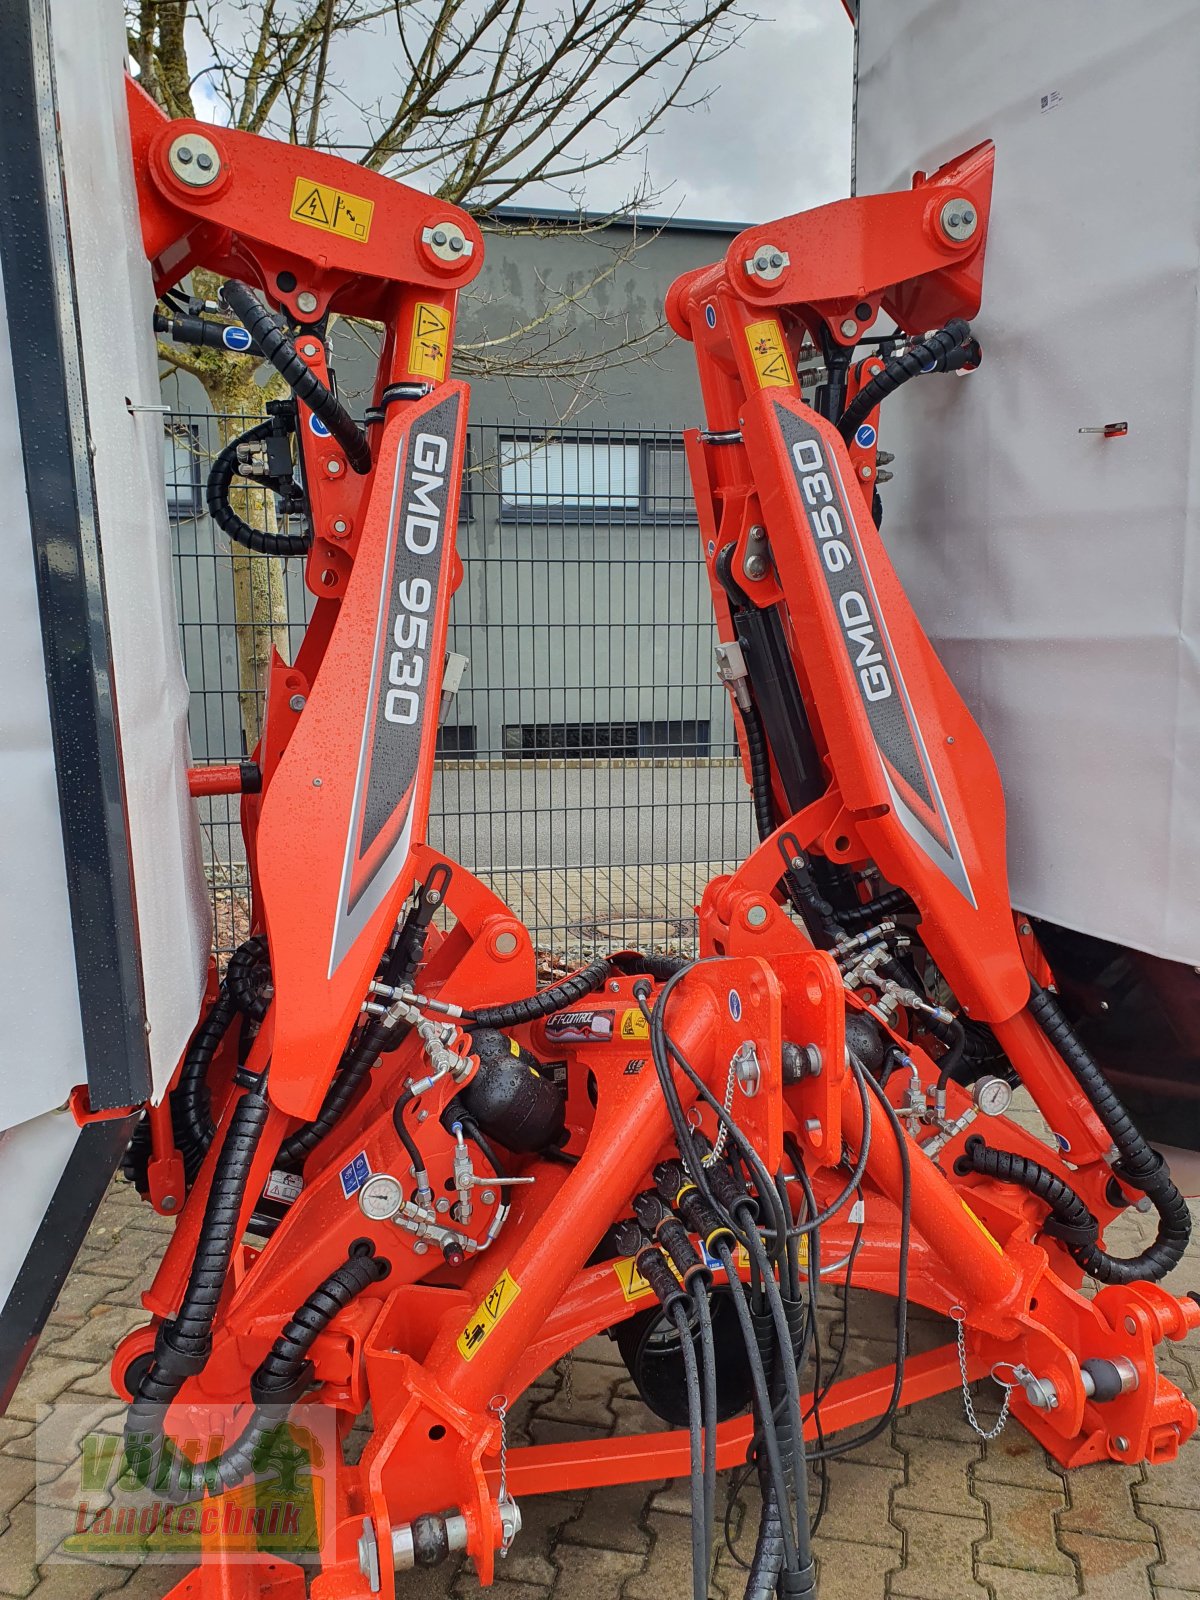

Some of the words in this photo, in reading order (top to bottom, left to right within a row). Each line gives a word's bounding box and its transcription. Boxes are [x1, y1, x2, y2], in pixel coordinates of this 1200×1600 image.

[404, 432, 448, 555] GMD
[792, 439, 853, 573] 9530
[384, 577, 432, 725] 9530
[839, 590, 892, 701] GMD
